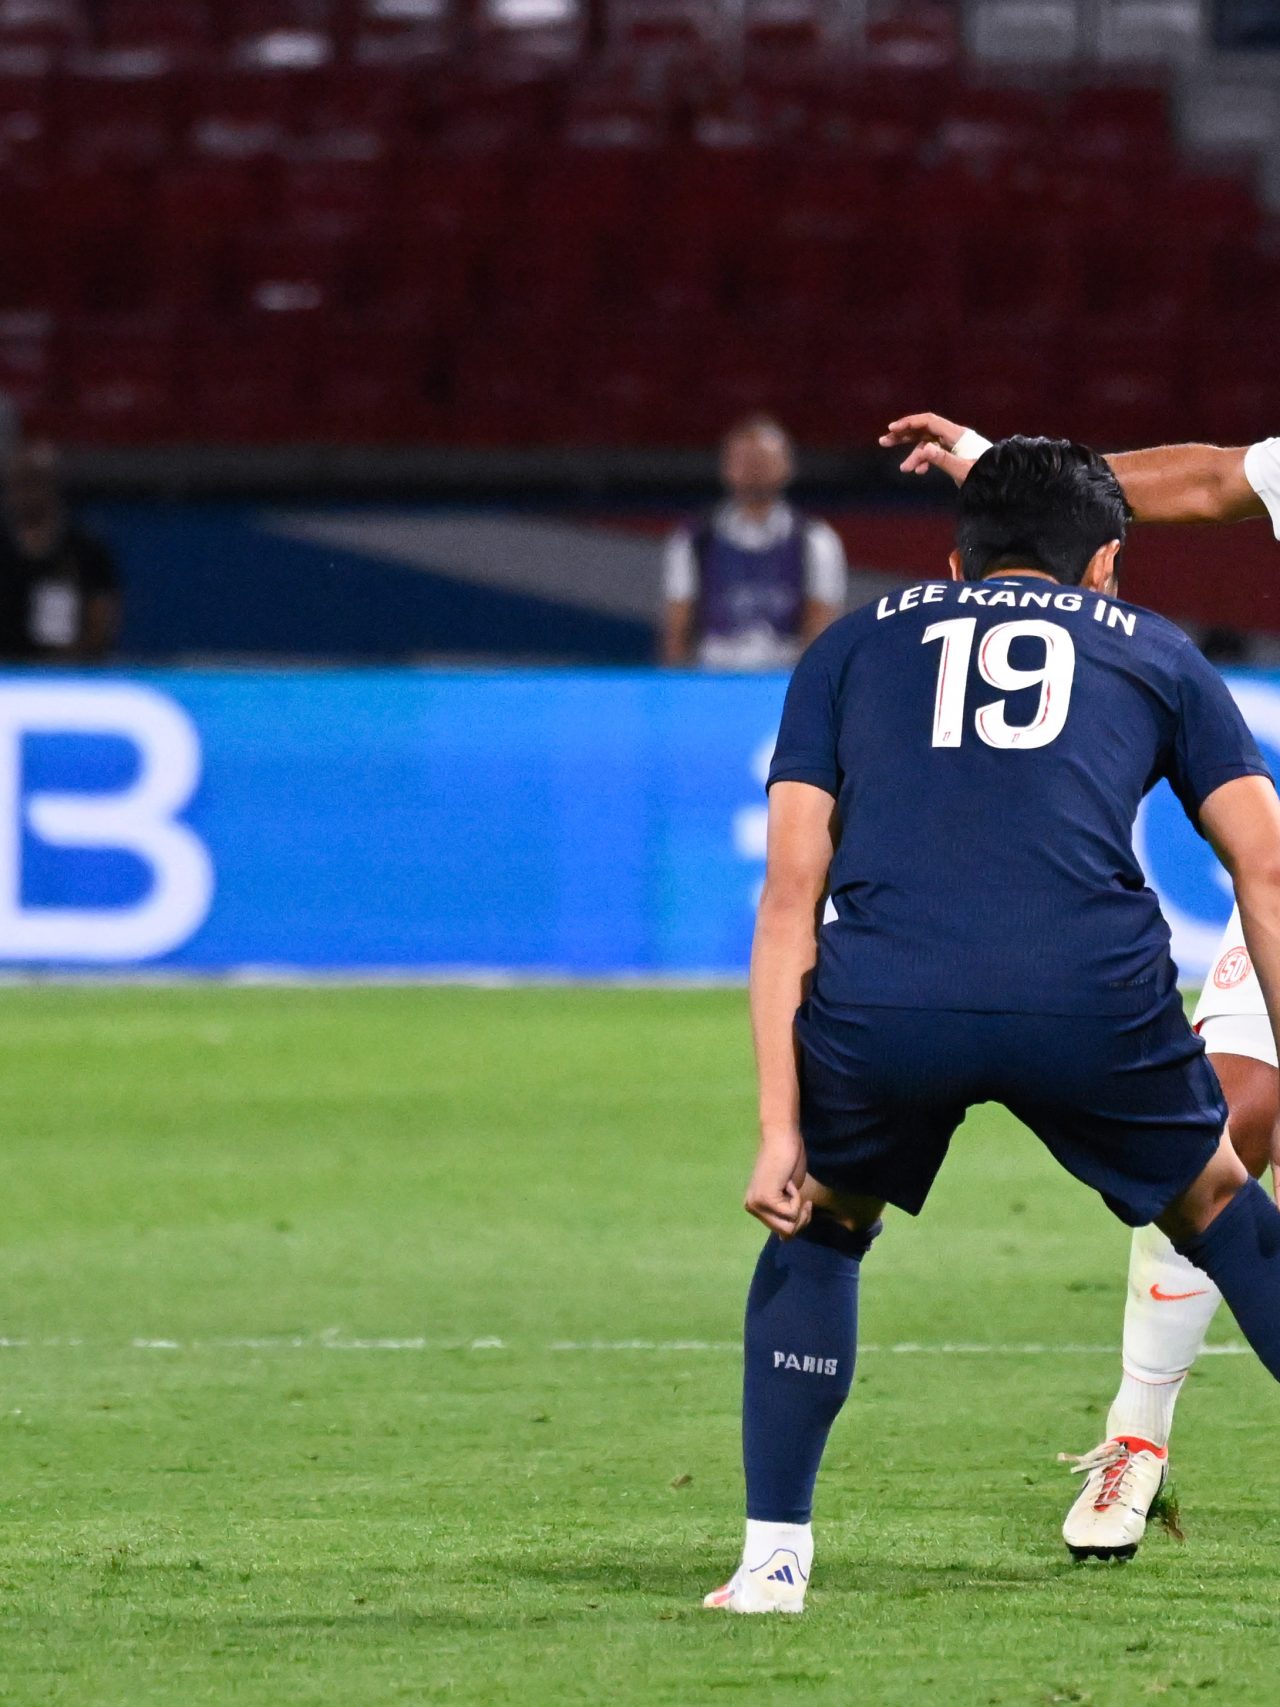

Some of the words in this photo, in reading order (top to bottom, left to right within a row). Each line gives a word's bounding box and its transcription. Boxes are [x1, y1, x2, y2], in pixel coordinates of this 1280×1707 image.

[877, 584, 948, 620] LEE
[957, 587, 1083, 612] KANG
[1093, 599, 1137, 637] IN
[921, 617, 1076, 749] 19
[773, 1350, 838, 1376] PARIS
